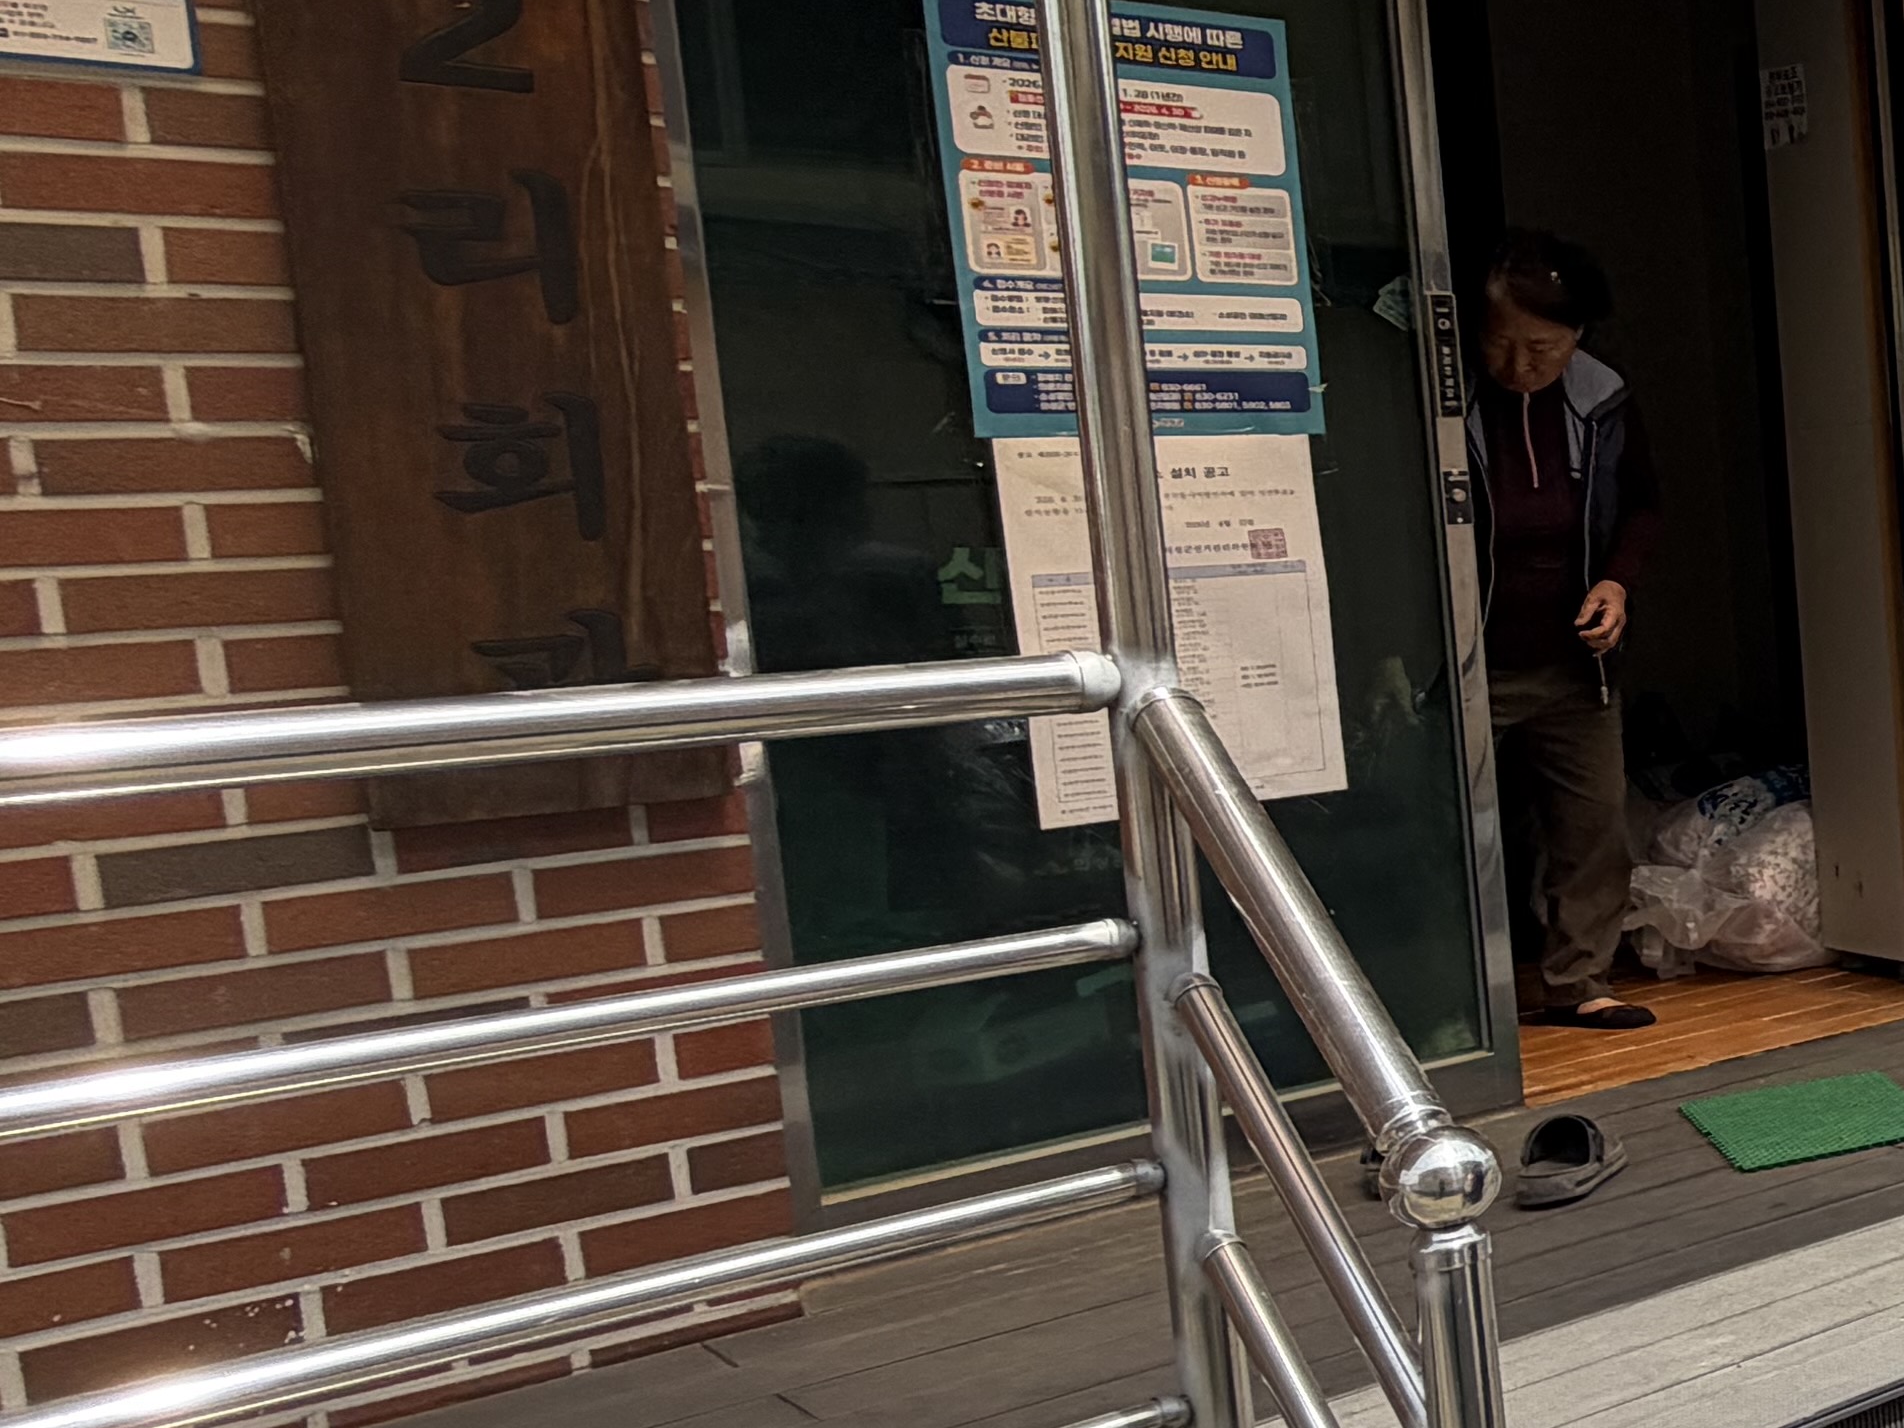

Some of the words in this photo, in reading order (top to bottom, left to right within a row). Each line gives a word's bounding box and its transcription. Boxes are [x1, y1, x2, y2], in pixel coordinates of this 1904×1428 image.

[1147, 22, 1202, 44] 시행에
[1206, 28, 1244, 50] 따른
[1115, 42, 1154, 63] 지원
[1158, 47, 1196, 67] 신청
[1199, 52, 1238, 72] 안내
[1170, 467, 1197, 479] 설치
[1203, 466, 1230, 479] 공고
